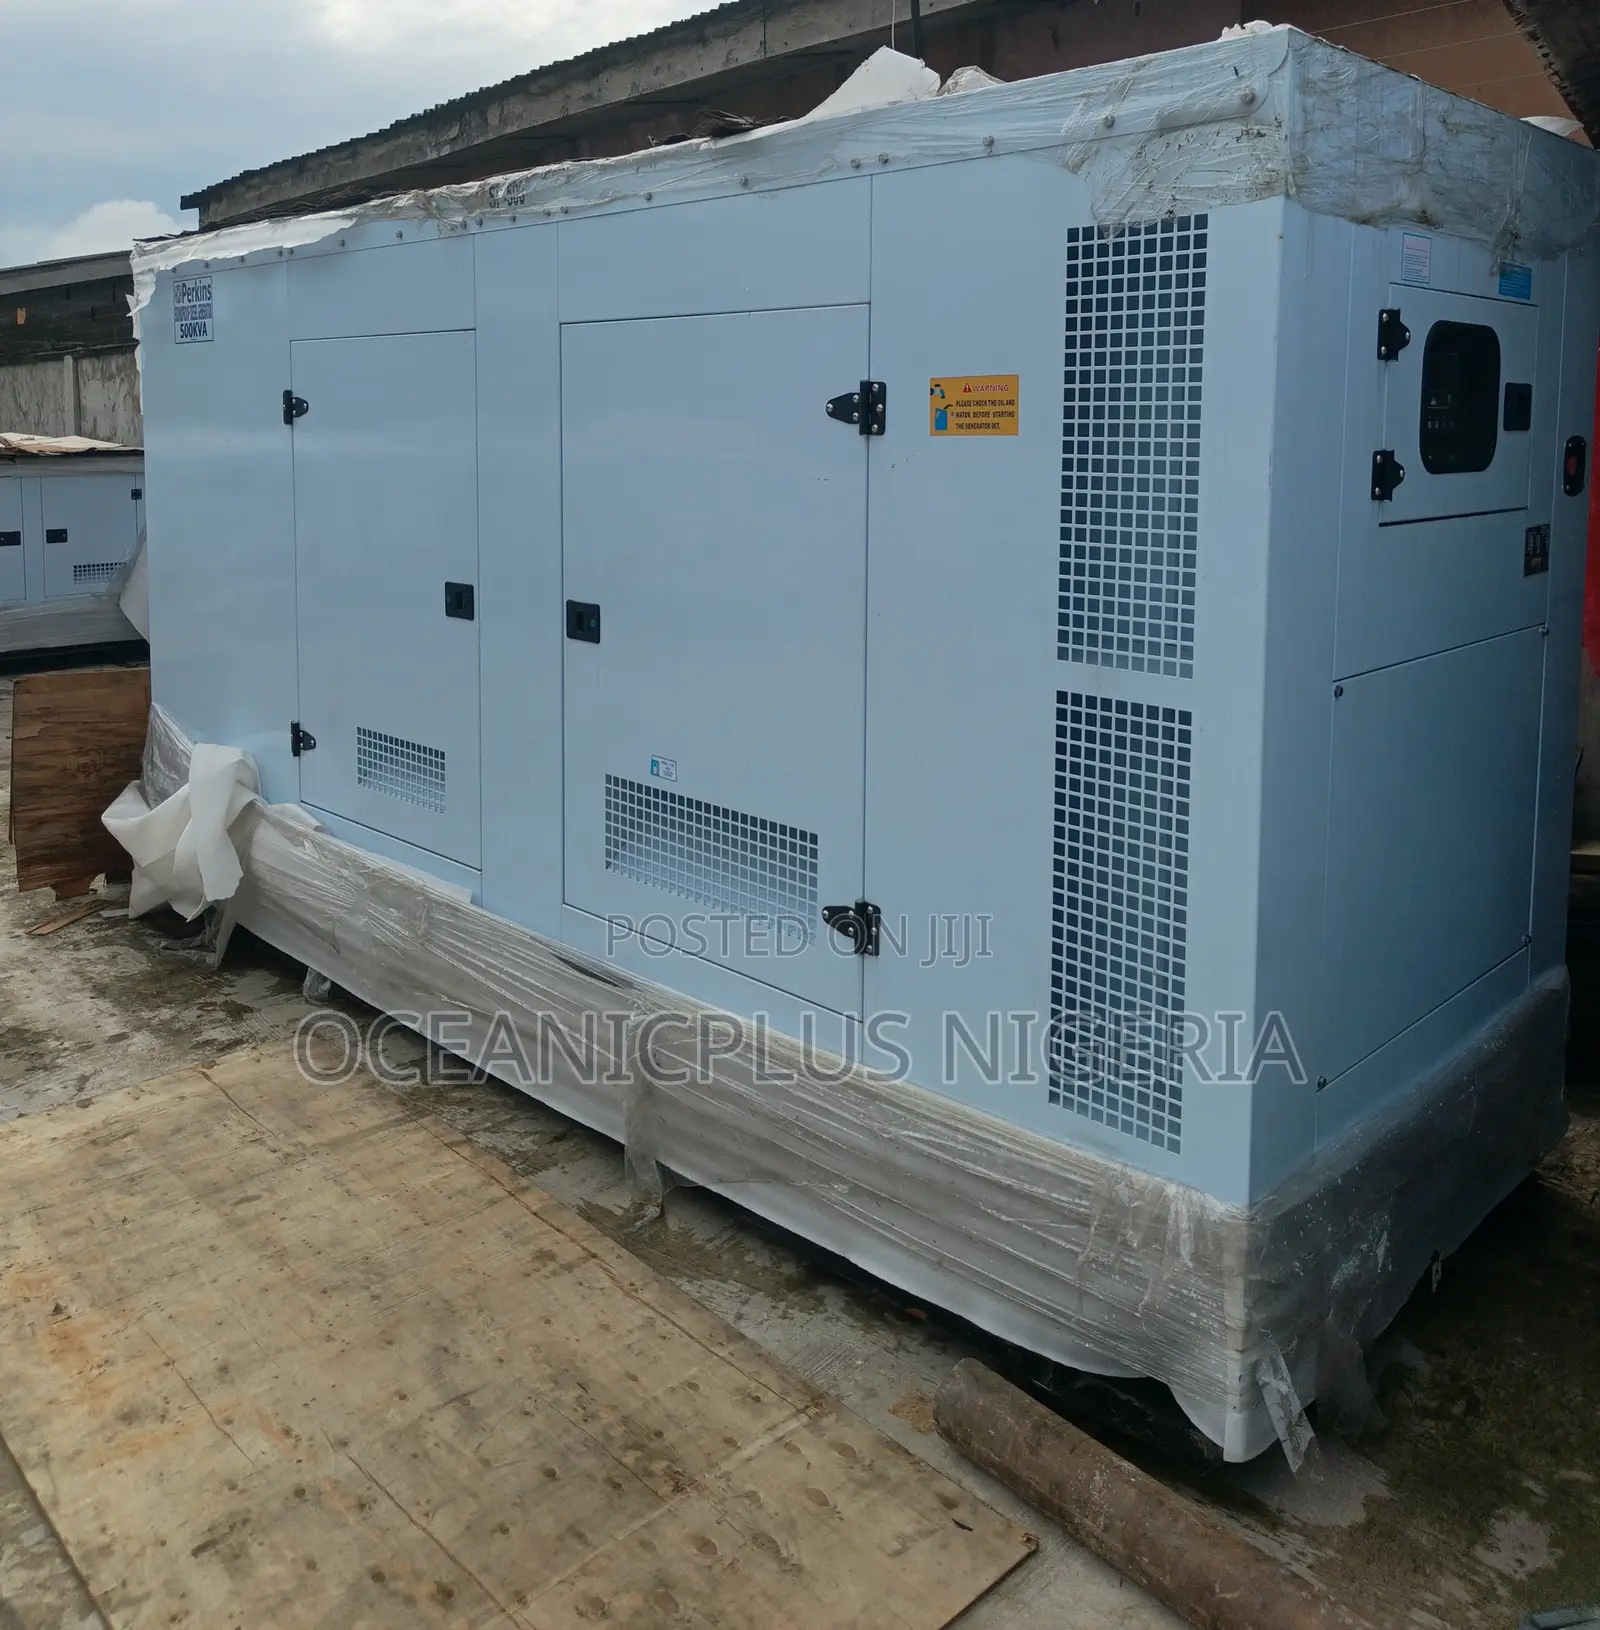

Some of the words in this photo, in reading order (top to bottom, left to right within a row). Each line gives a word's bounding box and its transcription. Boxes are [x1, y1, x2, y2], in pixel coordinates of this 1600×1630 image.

[181, 279, 212, 303] Perkins
[180, 321, 208, 339] 500KVA
[972, 384, 1009, 392] WARNING
[993, 410, 1015, 418] STARTING
